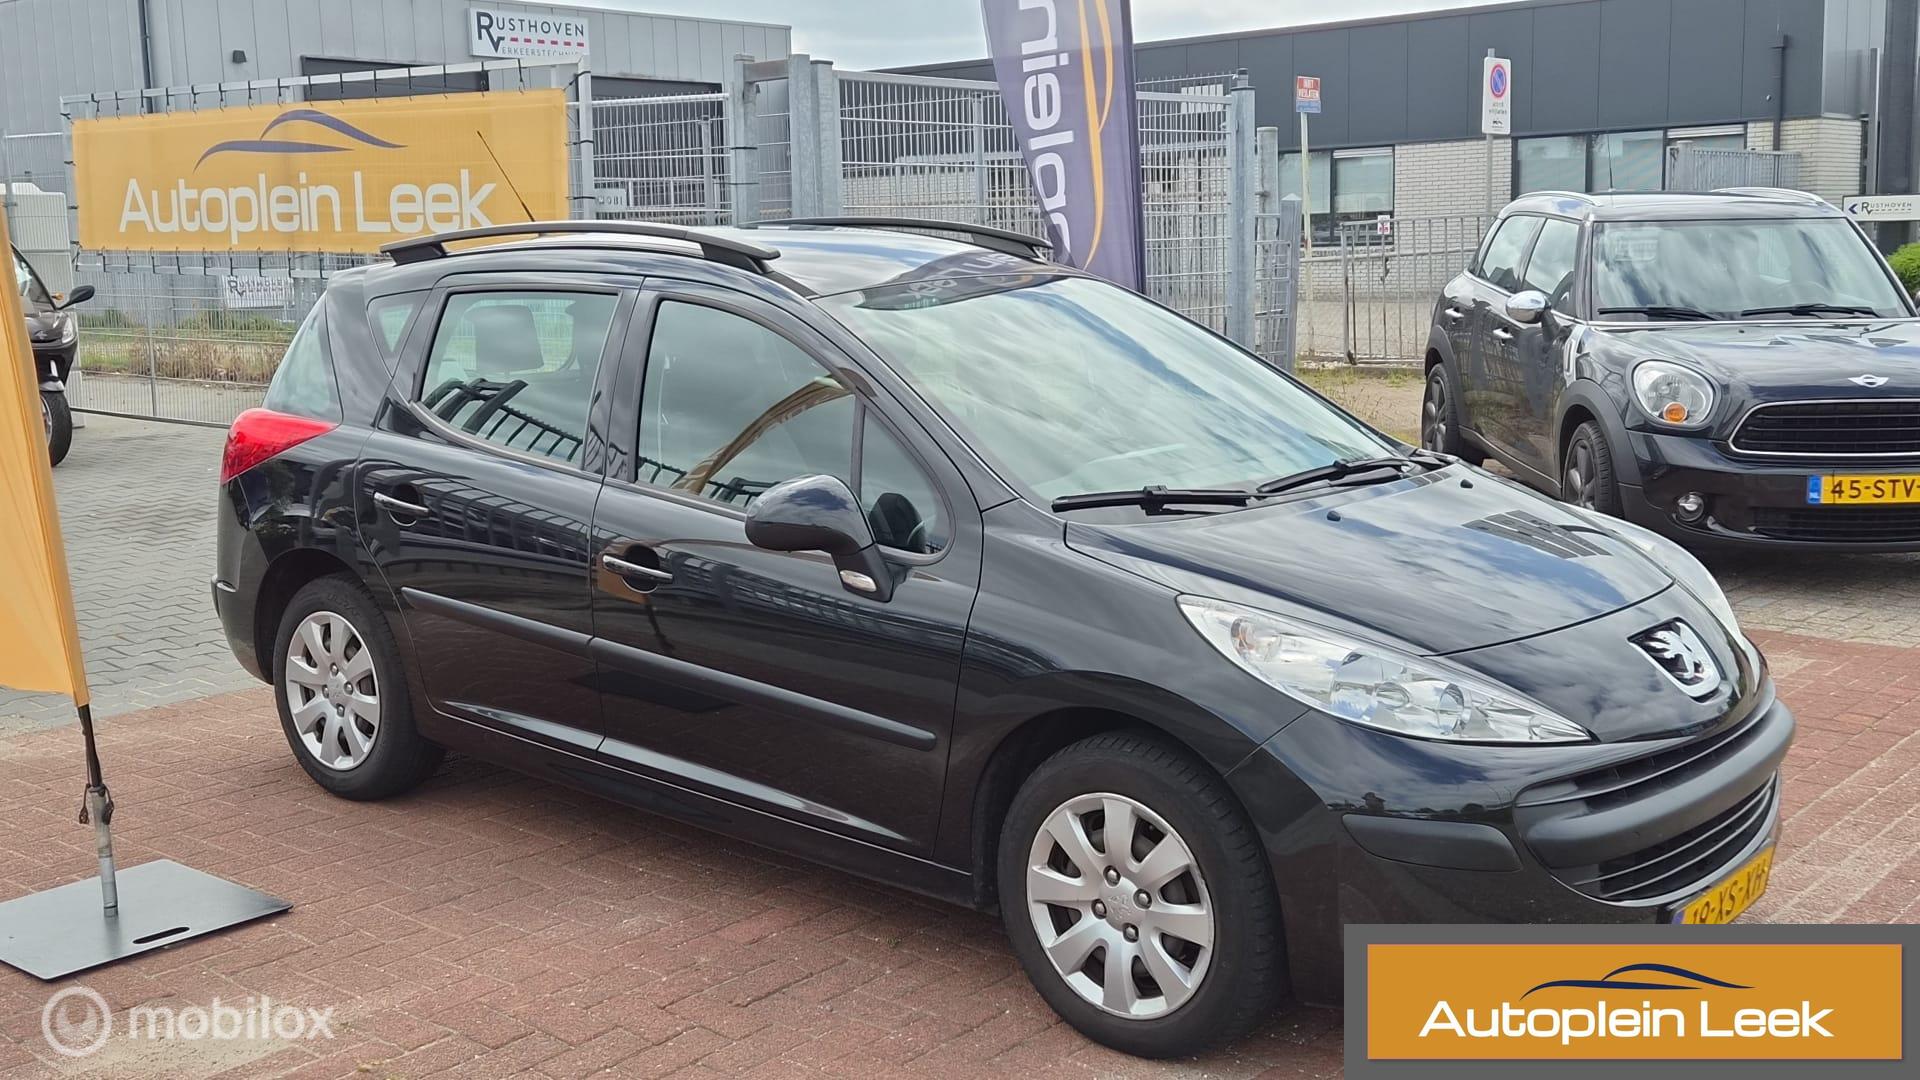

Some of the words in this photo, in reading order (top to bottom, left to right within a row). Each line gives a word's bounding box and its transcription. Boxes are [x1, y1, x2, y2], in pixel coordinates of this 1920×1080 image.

[476, 11, 584, 41] RUSTHOVEN
[119, 171, 342, 245] Autoplein
[354, 168, 497, 234] Leek
[1861, 201, 1912, 212] RUSTHOVEN
